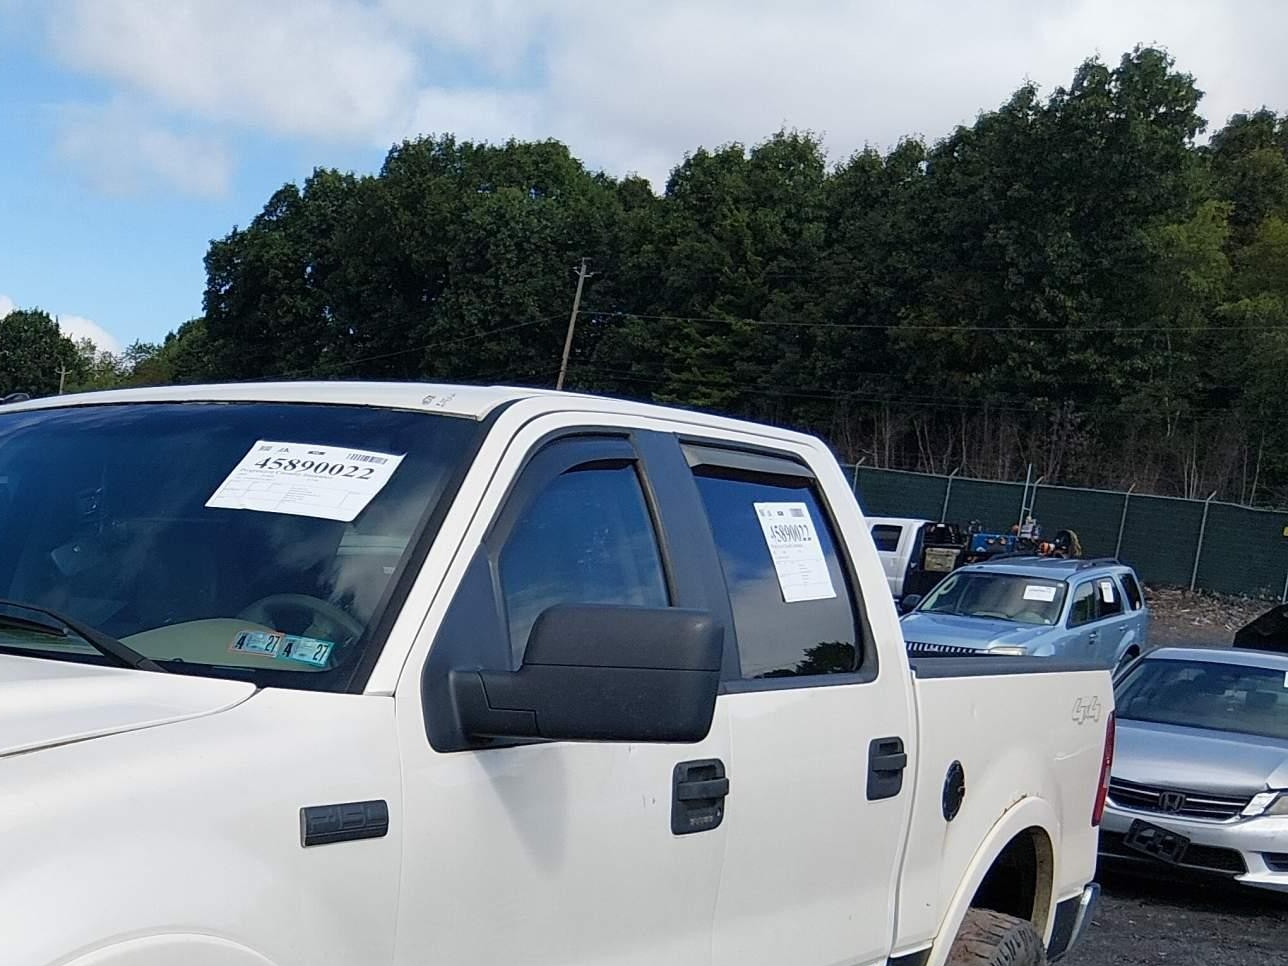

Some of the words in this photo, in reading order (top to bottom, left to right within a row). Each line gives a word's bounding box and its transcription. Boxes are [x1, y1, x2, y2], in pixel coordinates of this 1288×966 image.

[254, 456, 376, 481] 45890022
[264, 634, 281, 653] 27
[312, 643, 329, 662] 27
